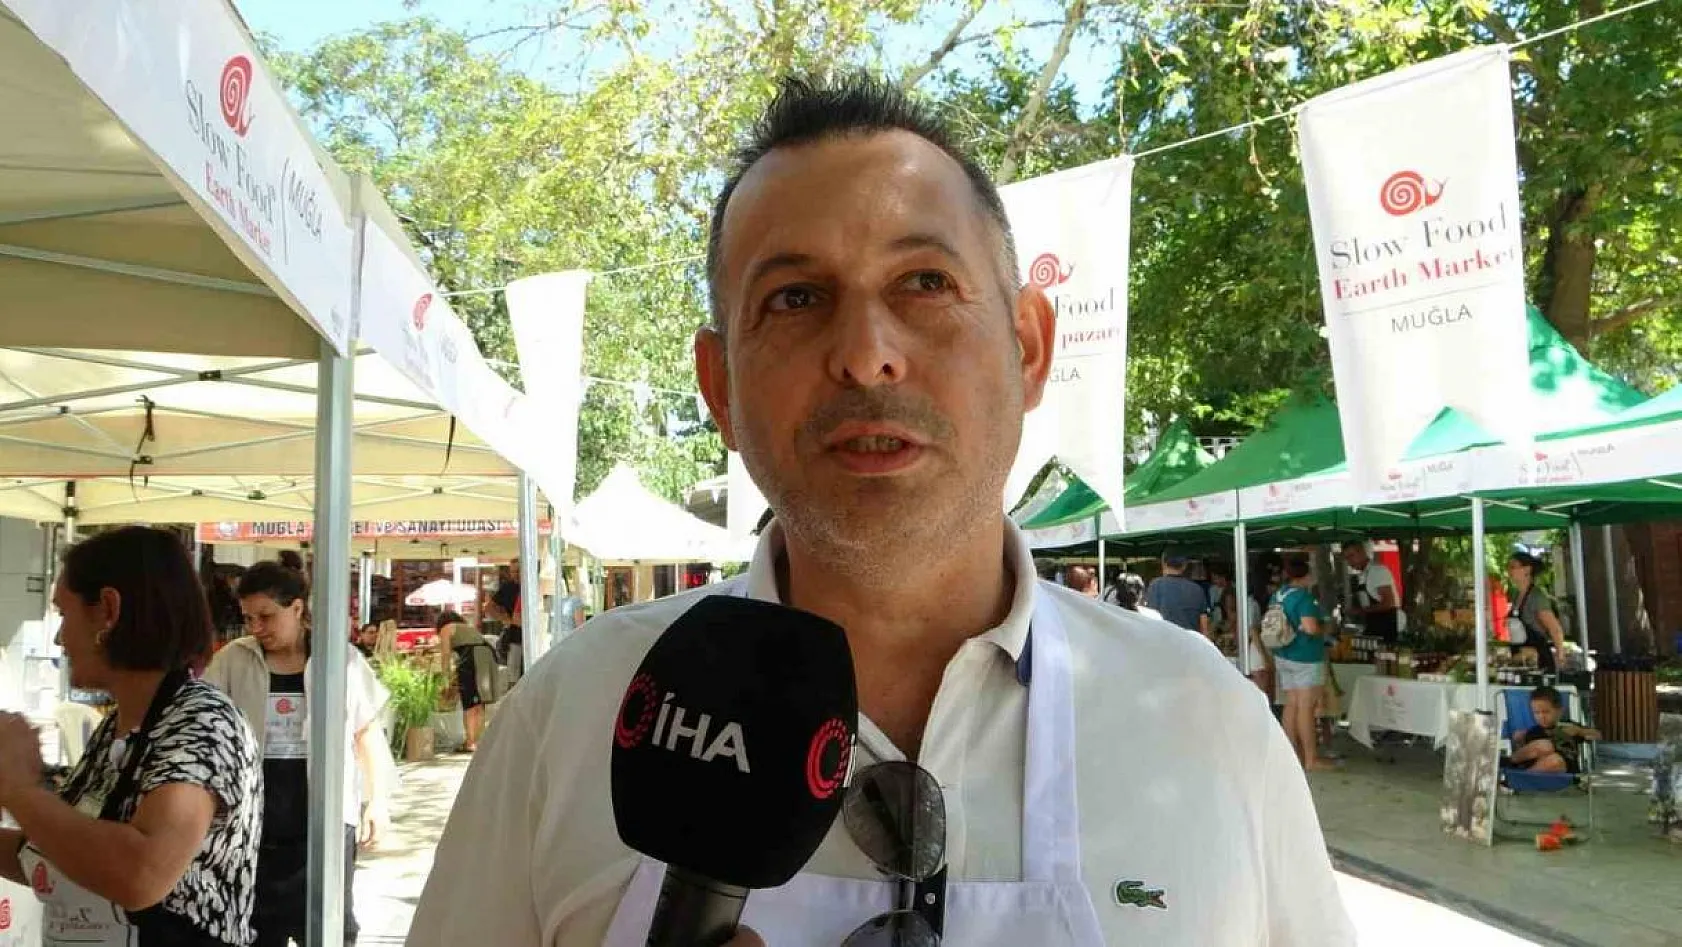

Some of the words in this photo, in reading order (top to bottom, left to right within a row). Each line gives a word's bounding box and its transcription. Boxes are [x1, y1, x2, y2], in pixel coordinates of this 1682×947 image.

[1330, 235, 1408, 270] Slow
[1422, 201, 1507, 248] Food
[1333, 267, 1408, 300] Earth
[1390, 303, 1473, 333] MUĞLA
[652, 692, 751, 774] İHA
